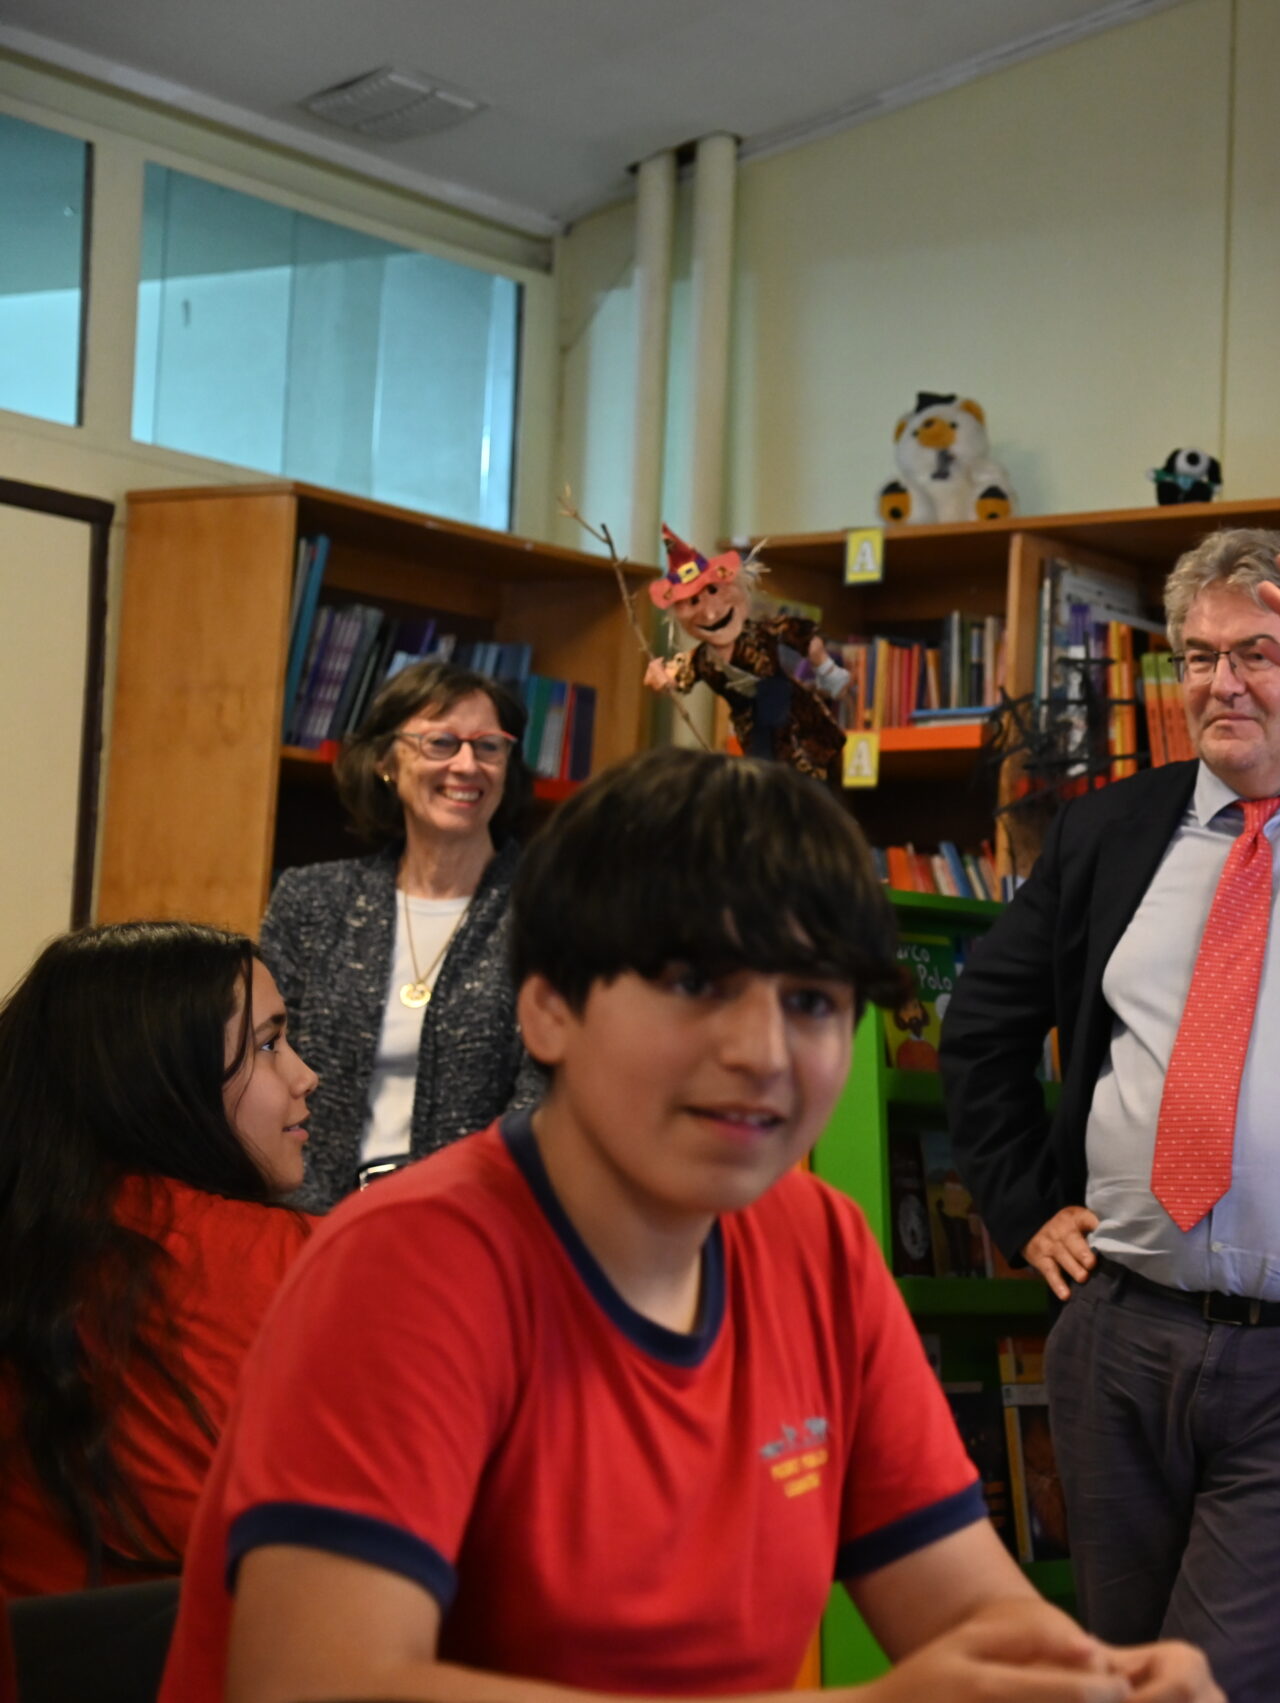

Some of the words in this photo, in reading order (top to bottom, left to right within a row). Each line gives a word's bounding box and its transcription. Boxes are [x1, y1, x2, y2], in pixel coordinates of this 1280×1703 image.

[852, 539, 878, 573] A
[848, 742, 874, 777] A
[916, 963, 953, 991] Polo
